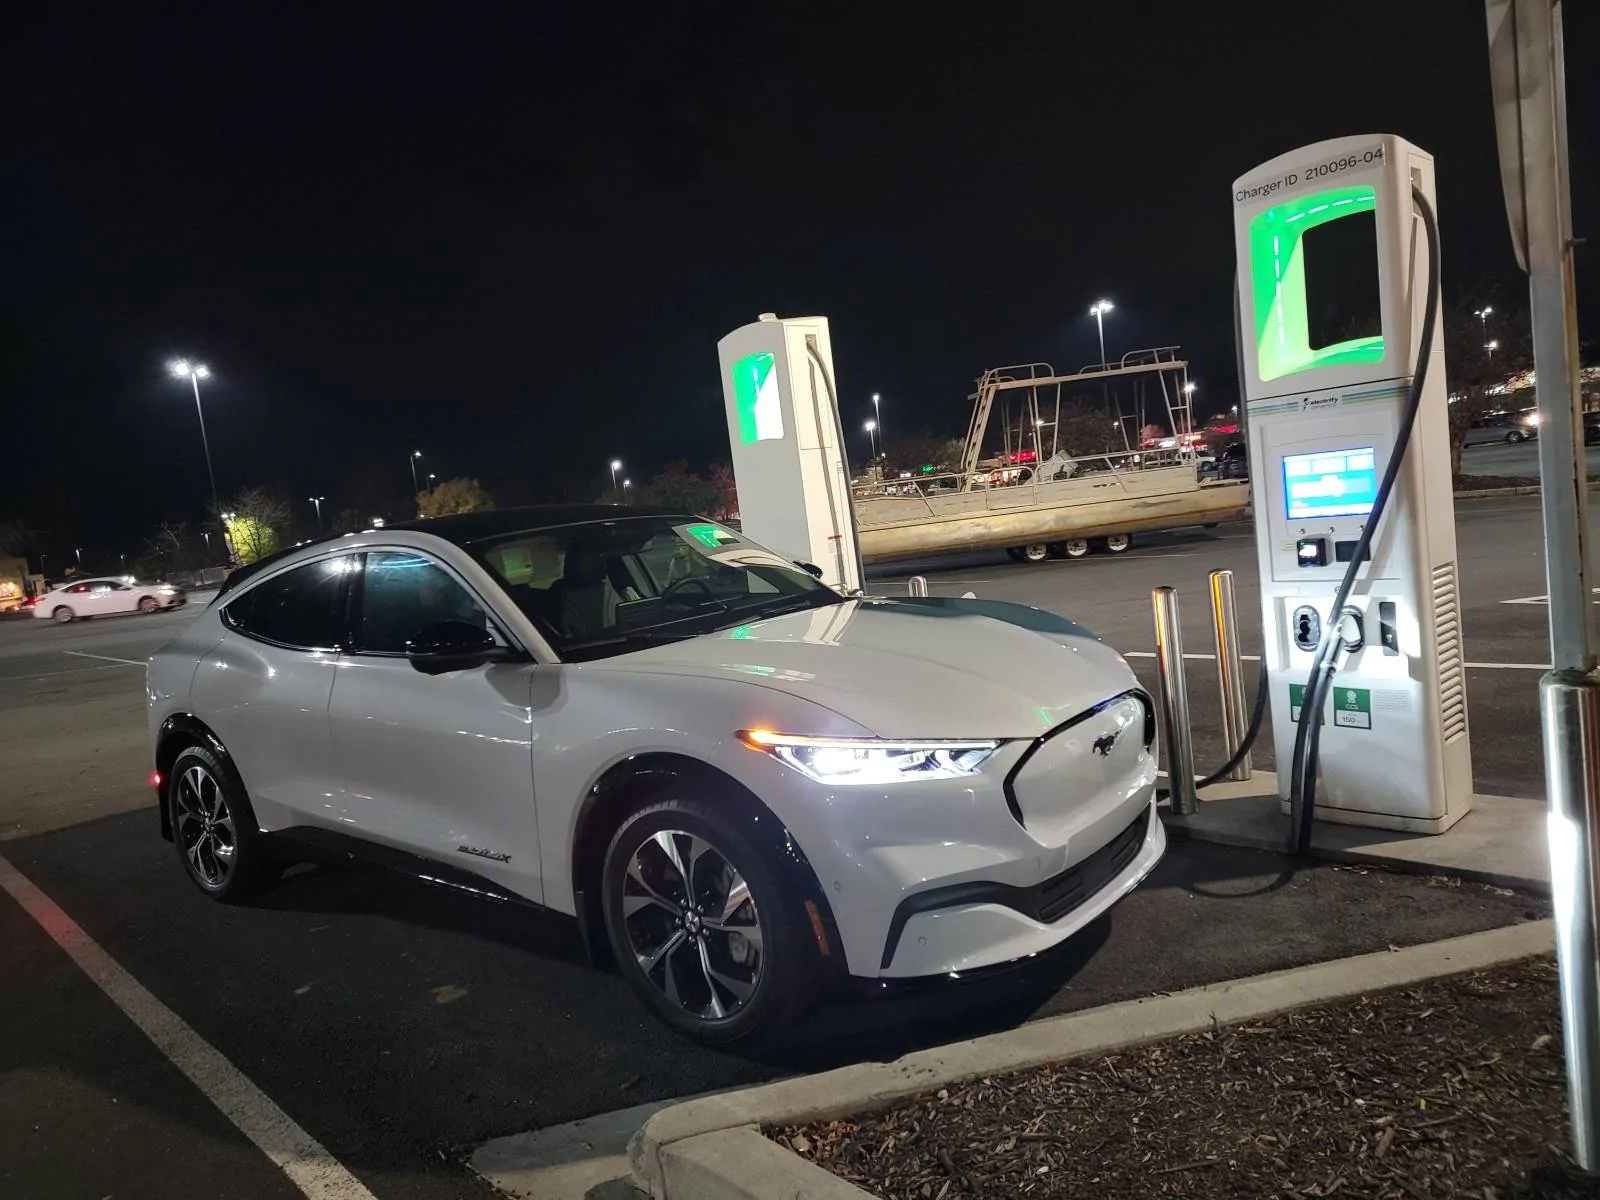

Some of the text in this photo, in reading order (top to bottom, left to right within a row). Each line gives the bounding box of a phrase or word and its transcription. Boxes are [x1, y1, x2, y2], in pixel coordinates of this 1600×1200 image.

[1236, 148, 1383, 201] Charger ID 210096-04
